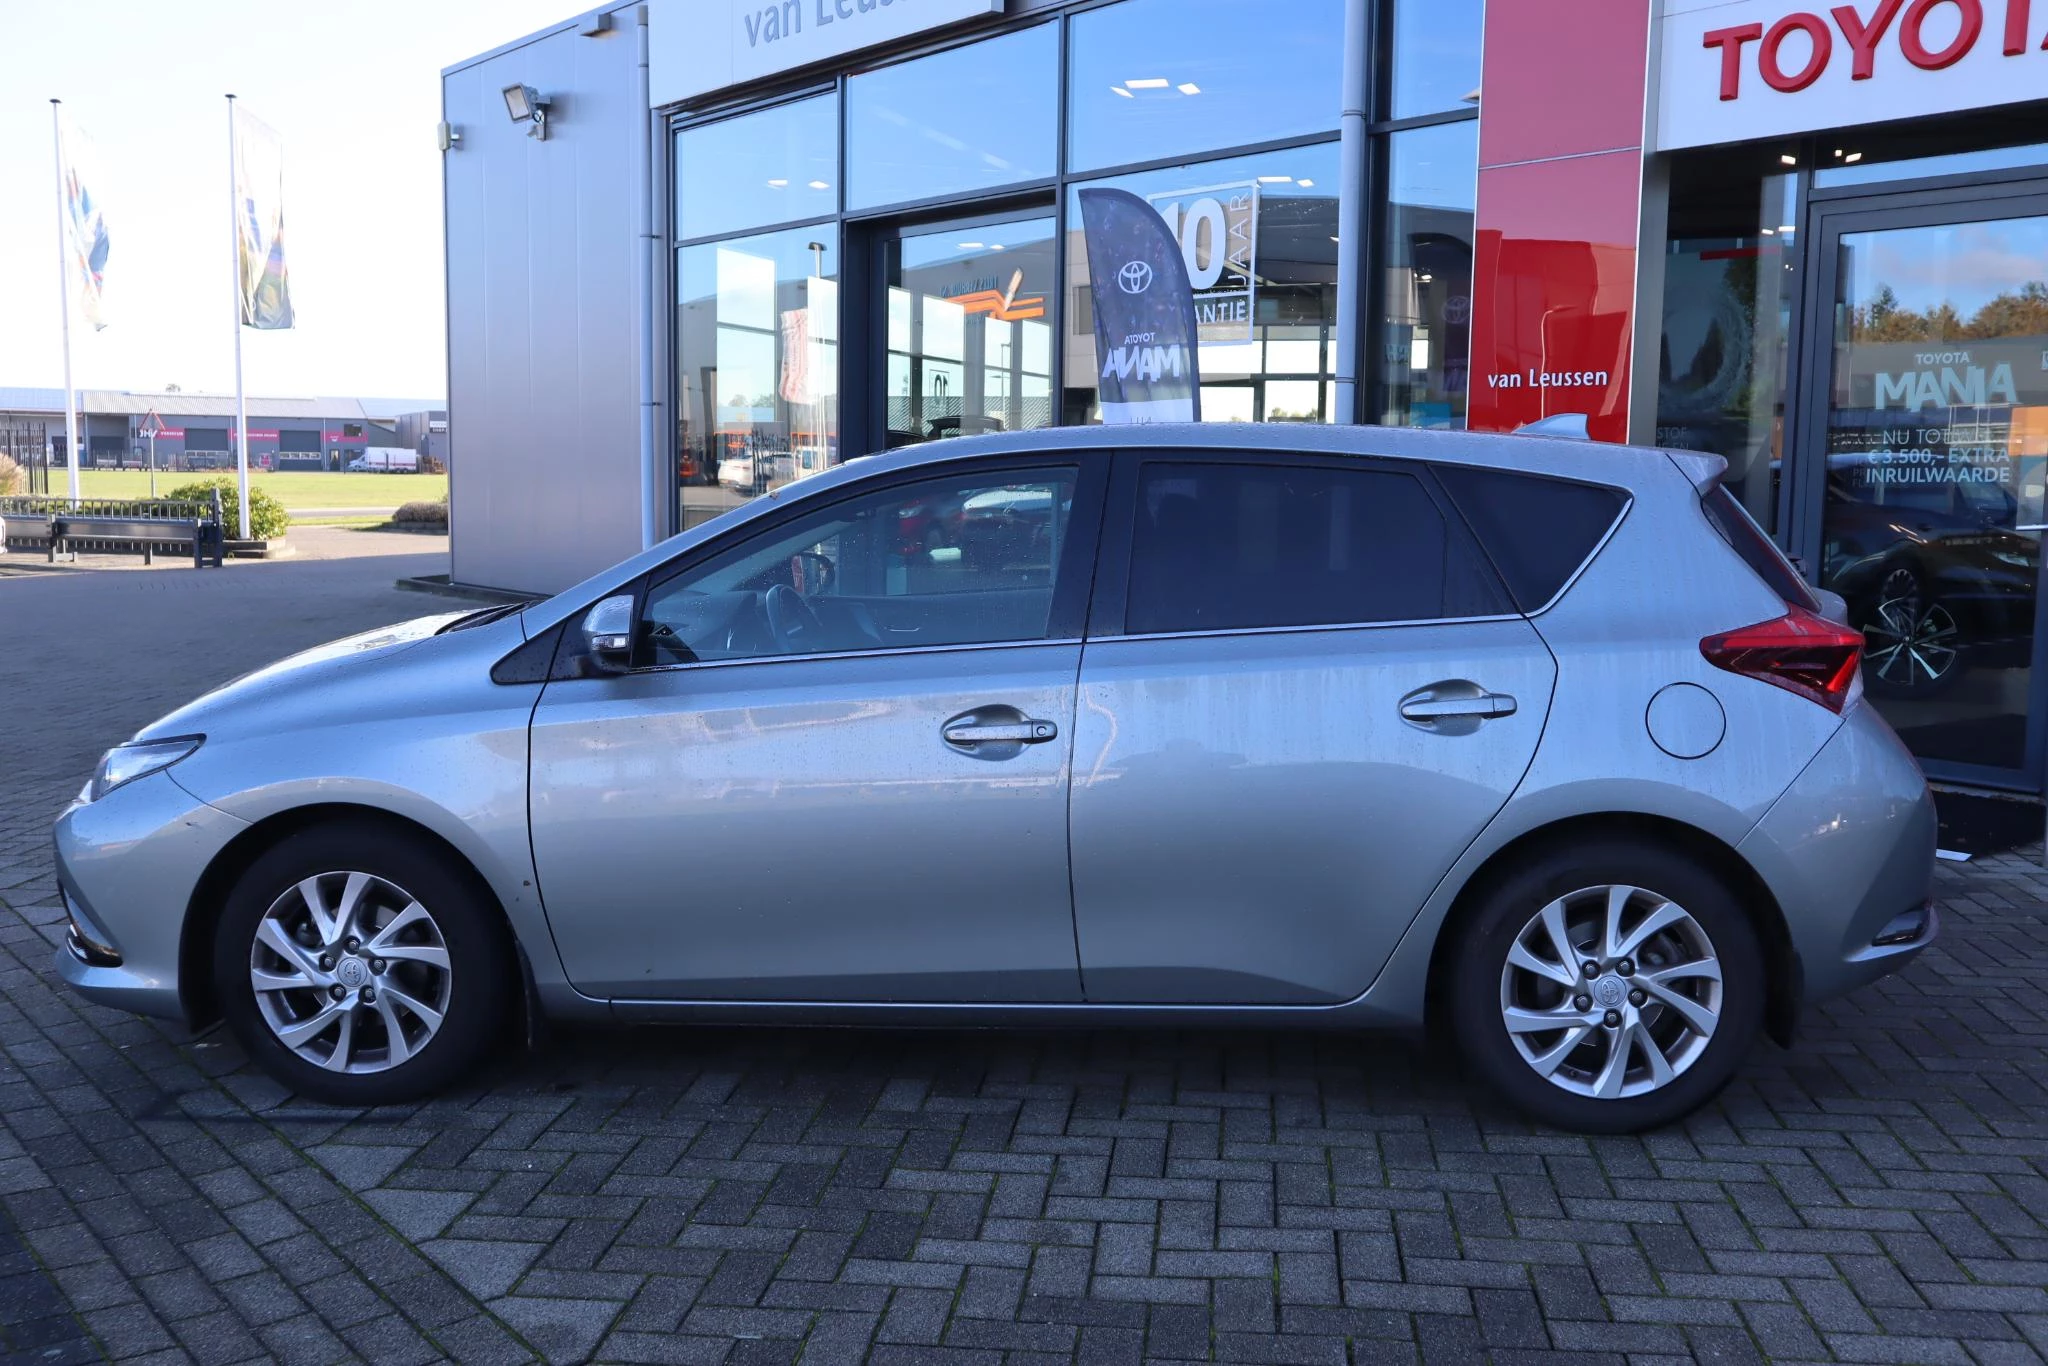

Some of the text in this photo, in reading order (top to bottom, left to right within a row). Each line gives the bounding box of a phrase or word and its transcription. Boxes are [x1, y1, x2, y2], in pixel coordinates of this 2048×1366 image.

[745, 0, 801, 48] van
[1703, 0, 2048, 101] TOYOT
[1228, 192, 1250, 286] JAAR
[1916, 352, 1970, 365] TOYOTA
[1487, 373, 1521, 388] van
[1529, 368, 1608, 387] Leussen
[1875, 363, 2018, 412] MANIA
[1883, 430, 1910, 445] NU
[1948, 448, 2010, 463] EXTRA
[1866, 467, 2010, 483] INRUILWAARDE
